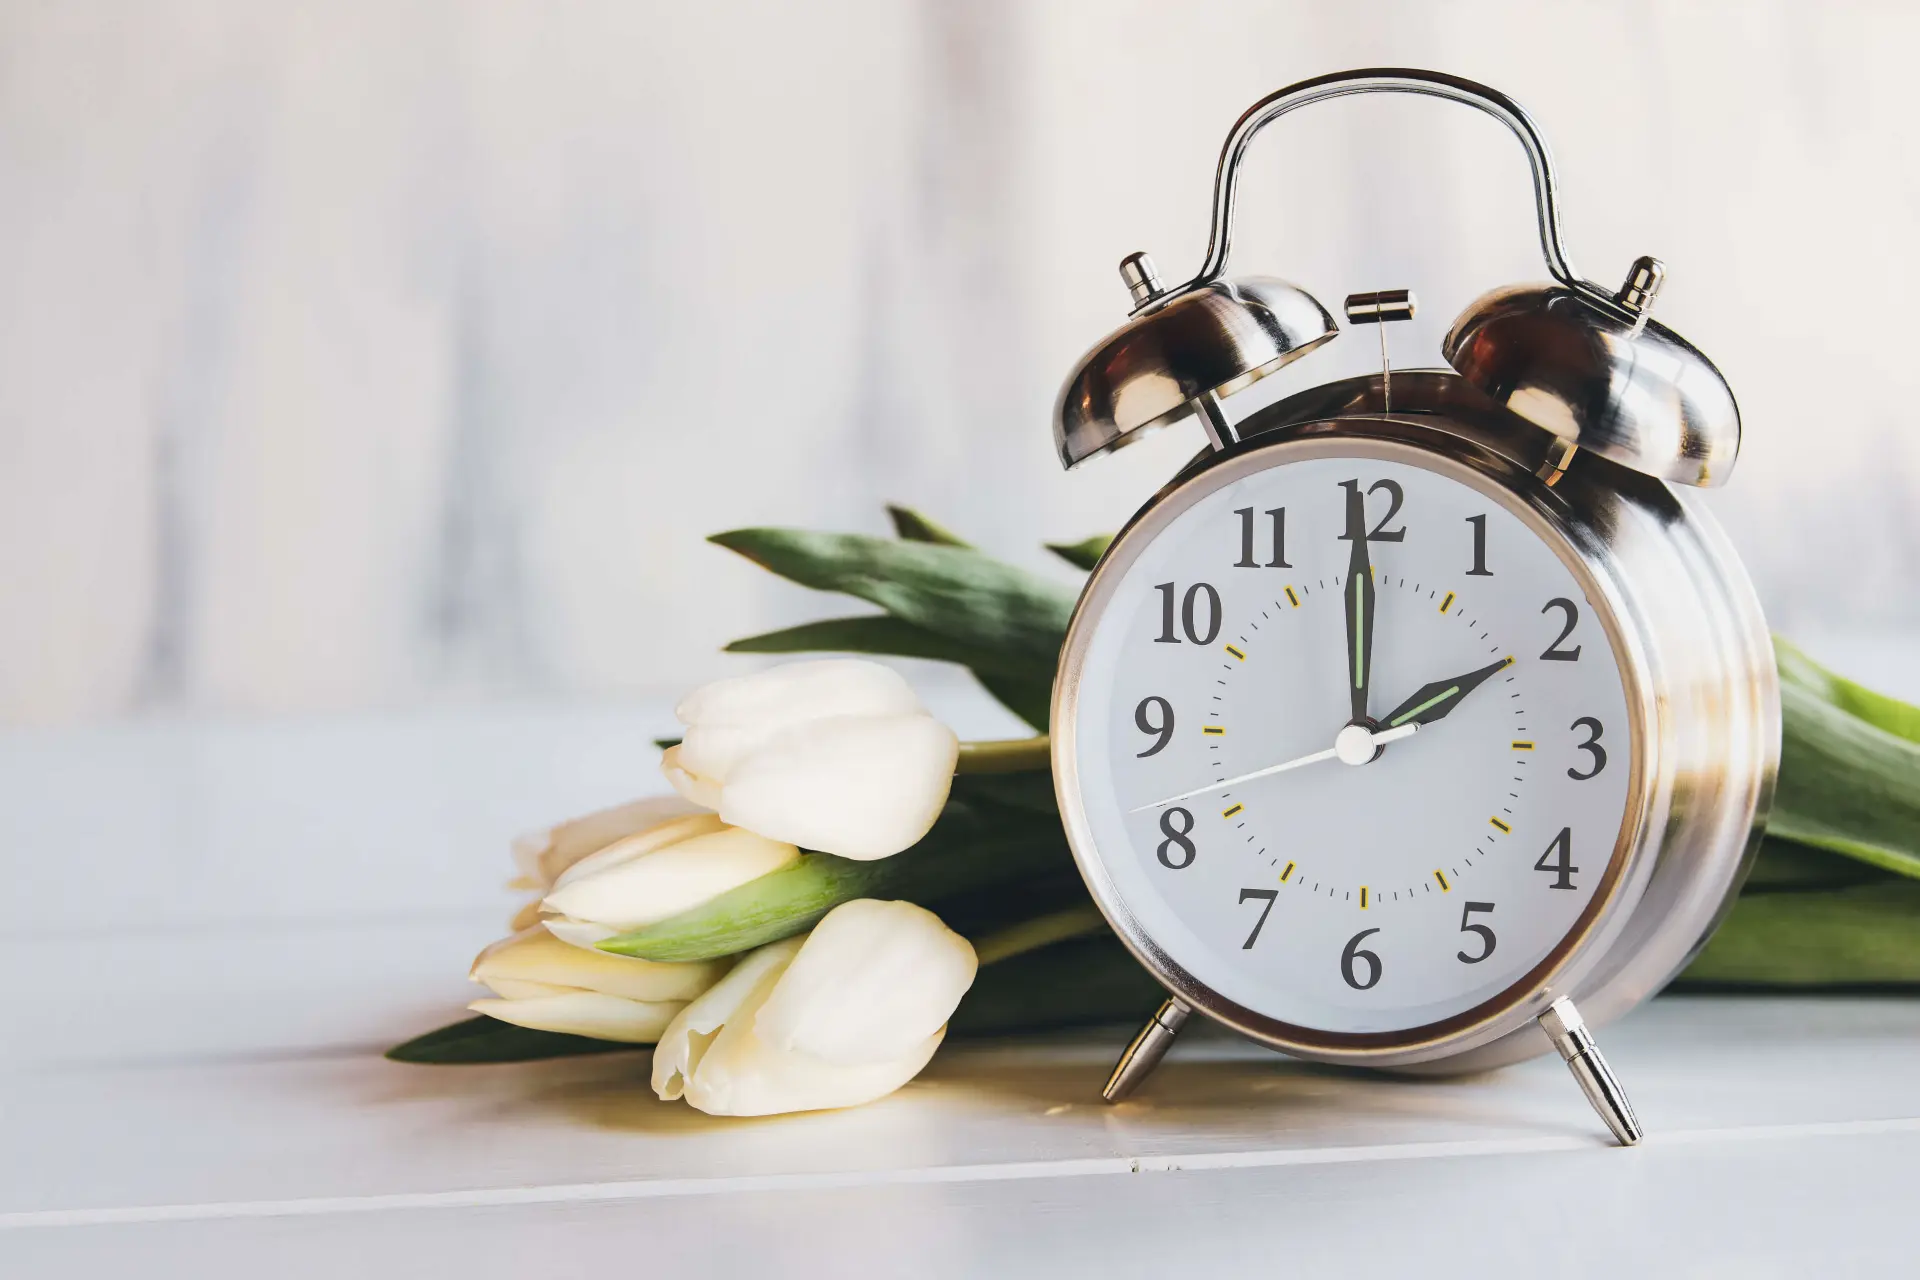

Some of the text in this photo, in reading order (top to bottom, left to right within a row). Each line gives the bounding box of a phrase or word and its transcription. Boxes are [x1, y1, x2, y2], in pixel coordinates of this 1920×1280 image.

[1233, 506, 1293, 569] 11
[1337, 478, 1407, 542] 12
[1465, 513, 1494, 577] 1
[1153, 581, 1222, 645] 10
[1539, 597, 1582, 662] 2
[1134, 695, 1175, 759] 9
[1566, 716, 1608, 781] 3
[1156, 806, 1197, 870] 8
[1533, 826, 1580, 891] 4
[1238, 887, 1280, 950] 7
[1456, 901, 1497, 965] 5
[1340, 927, 1383, 991] 6
